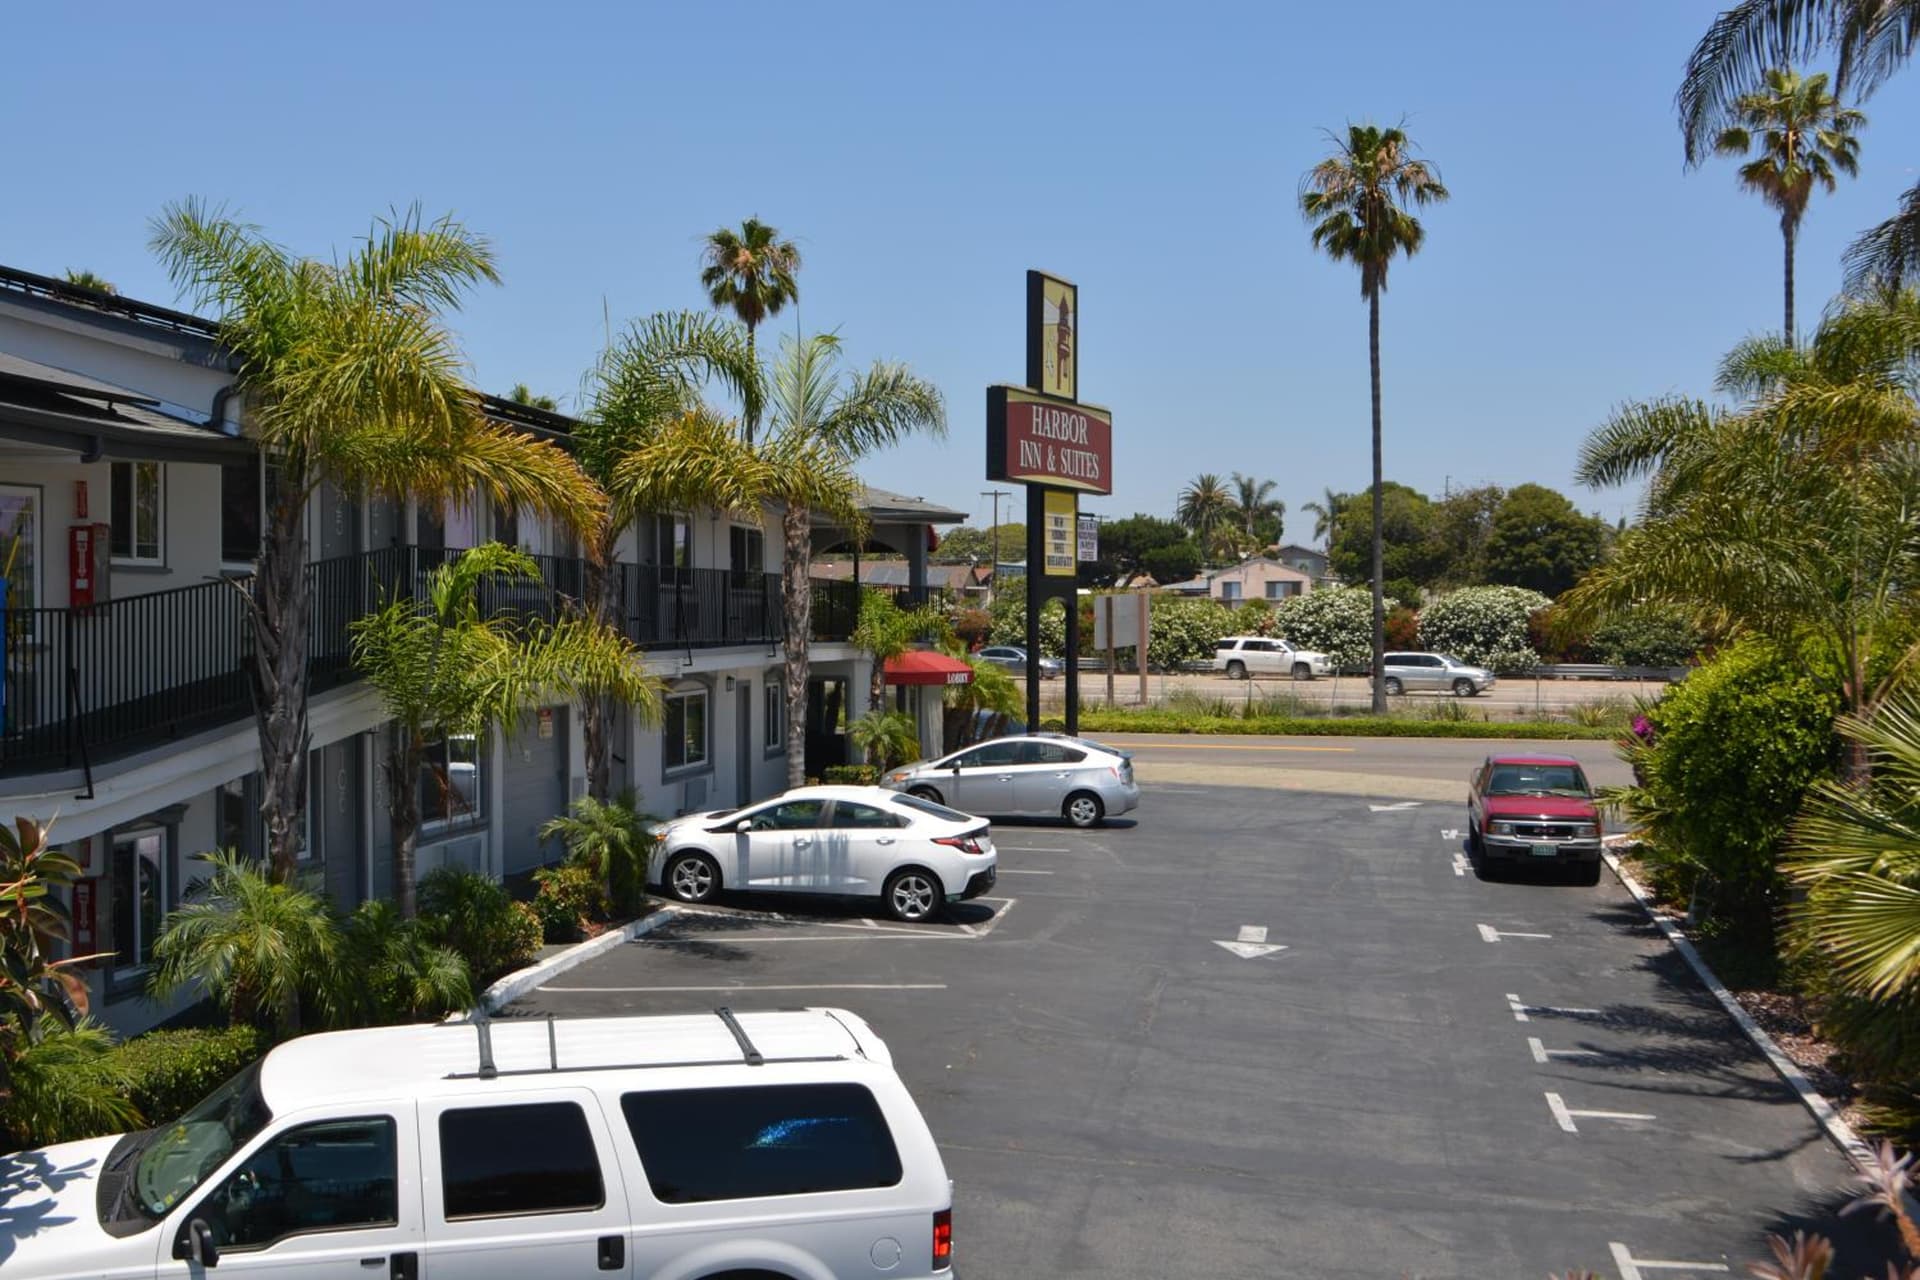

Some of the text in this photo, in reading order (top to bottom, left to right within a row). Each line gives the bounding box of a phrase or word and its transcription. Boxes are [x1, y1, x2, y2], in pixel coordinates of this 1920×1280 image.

[1032, 405, 1088, 445] HARBOR
[1020, 439, 1099, 480] INN & SUITES
